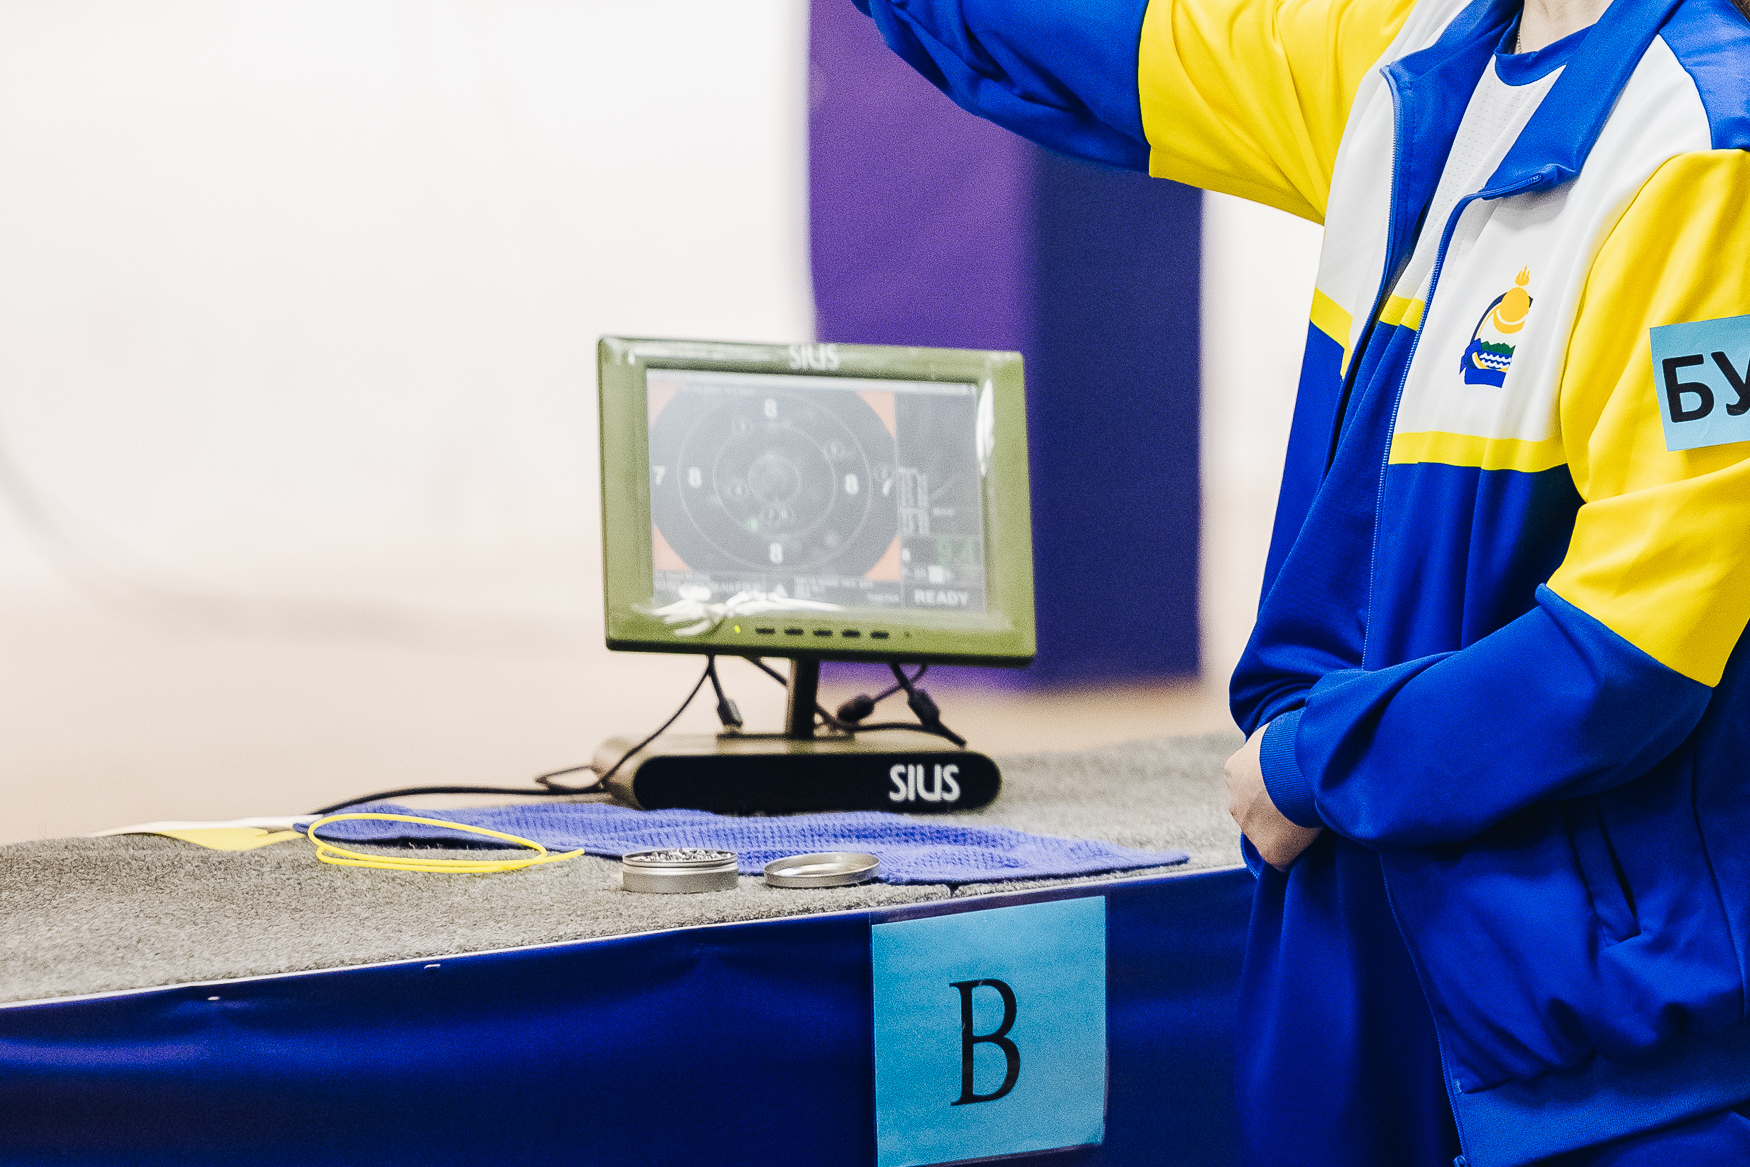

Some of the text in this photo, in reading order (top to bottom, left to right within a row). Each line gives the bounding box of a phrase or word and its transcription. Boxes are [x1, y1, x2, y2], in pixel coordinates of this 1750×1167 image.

[789, 343, 840, 371] SIUS
[764, 398, 778, 419] 8
[653, 464, 666, 486] 7
[688, 466, 702, 489] 8
[769, 542, 783, 565] 8
[914, 589, 969, 606] READY
[889, 763, 961, 802] SIUS
[949, 979, 1021, 1106] B
